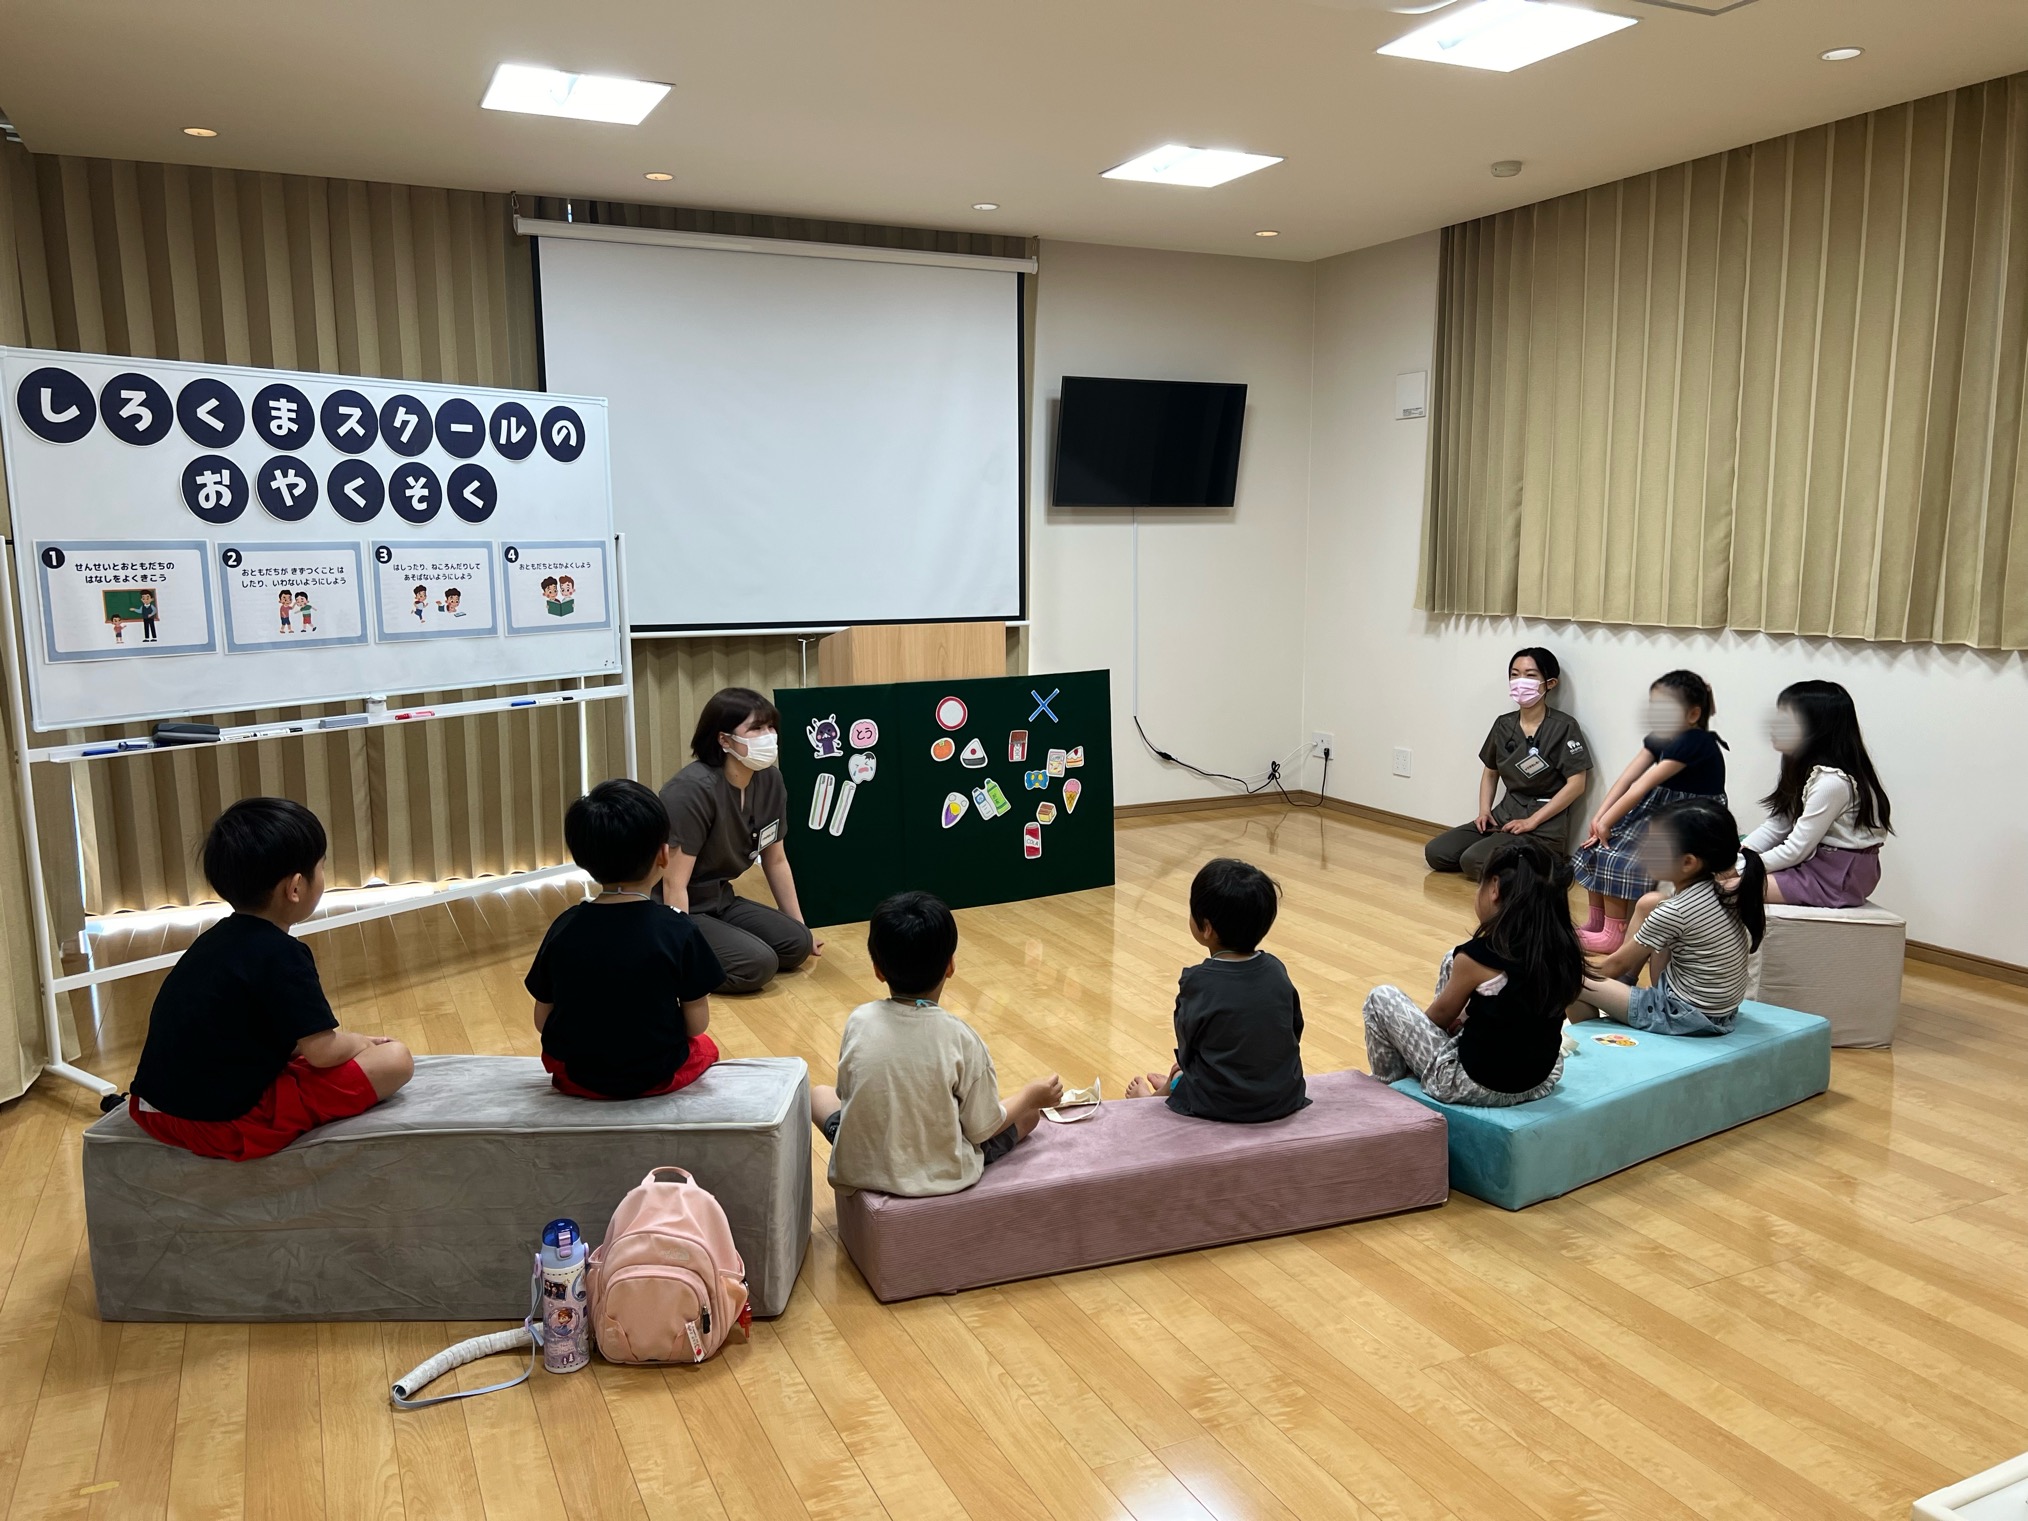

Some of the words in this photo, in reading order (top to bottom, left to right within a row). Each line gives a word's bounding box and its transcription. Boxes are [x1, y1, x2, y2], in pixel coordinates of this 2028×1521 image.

[40, 386, 578, 449] しろくまスクールの
[196, 467, 485, 510] おやくそく
[49, 551, 58, 566] 1
[227, 552, 237, 566] 2
[379, 548, 389, 561] 3
[507, 549, 516, 561] 4
[75, 562, 175, 572] せんせいとおともだちの
[393, 562, 481, 571] はしったり、ねころんだりして
[519, 561, 591, 570] おともだちとなかよくしよう
[242, 567, 288, 577] おともだちが
[290, 566, 334, 576] きずつくこと
[403, 572, 473, 581] あそばないようにしよう
[85, 573, 167, 584] はなしをよくきこう
[242, 577, 347, 588] したり、いわないようにしよう
[855, 728, 873, 741] とう
[1026, 838, 1039, 846] COLA
